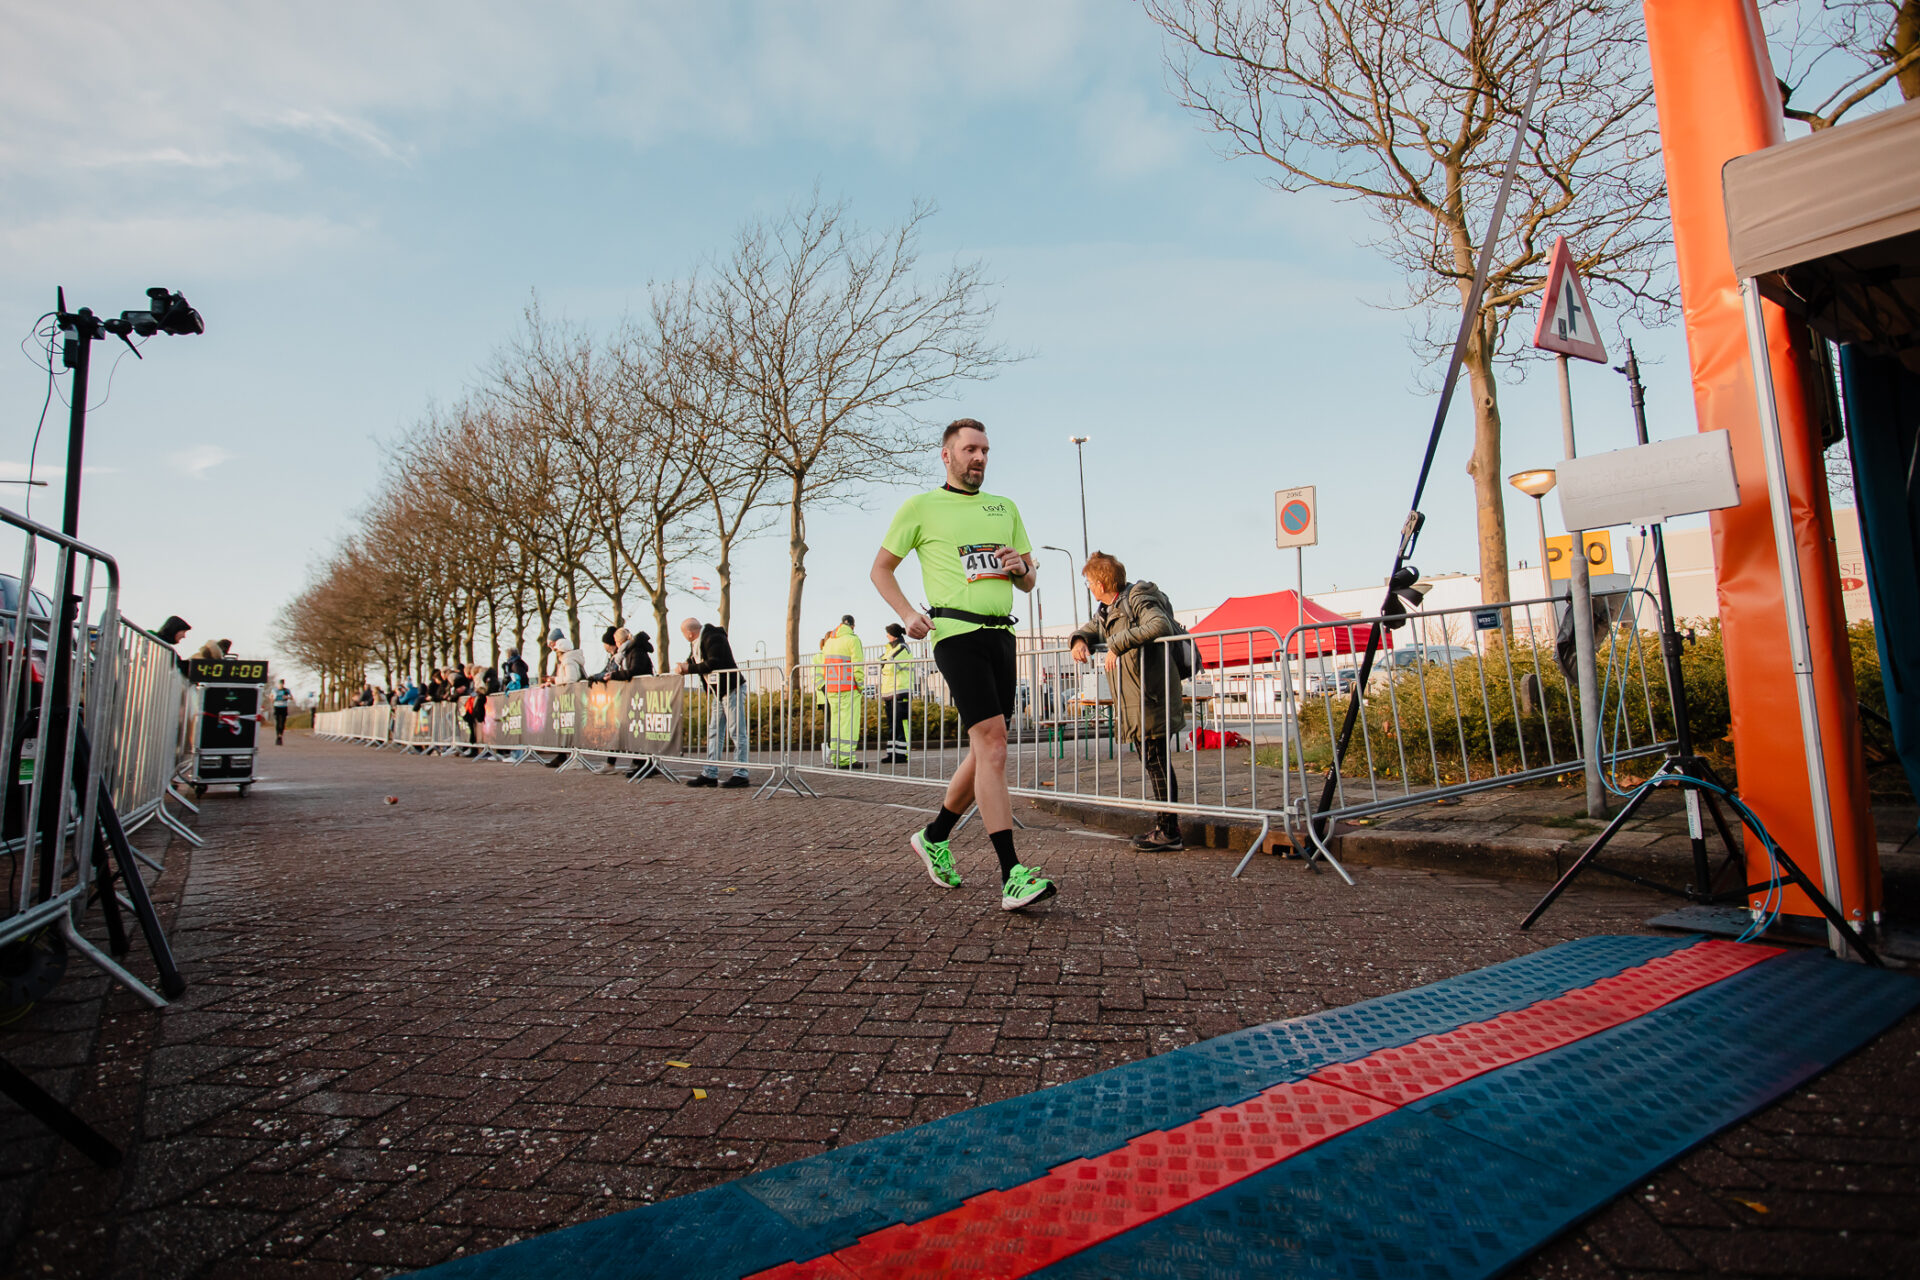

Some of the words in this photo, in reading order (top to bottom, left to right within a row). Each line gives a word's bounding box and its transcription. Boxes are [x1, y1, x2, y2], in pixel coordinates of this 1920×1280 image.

[1286, 490, 1303, 498] ZONE
[645, 690, 673, 713] VALK
[645, 713, 673, 732] EVENT
